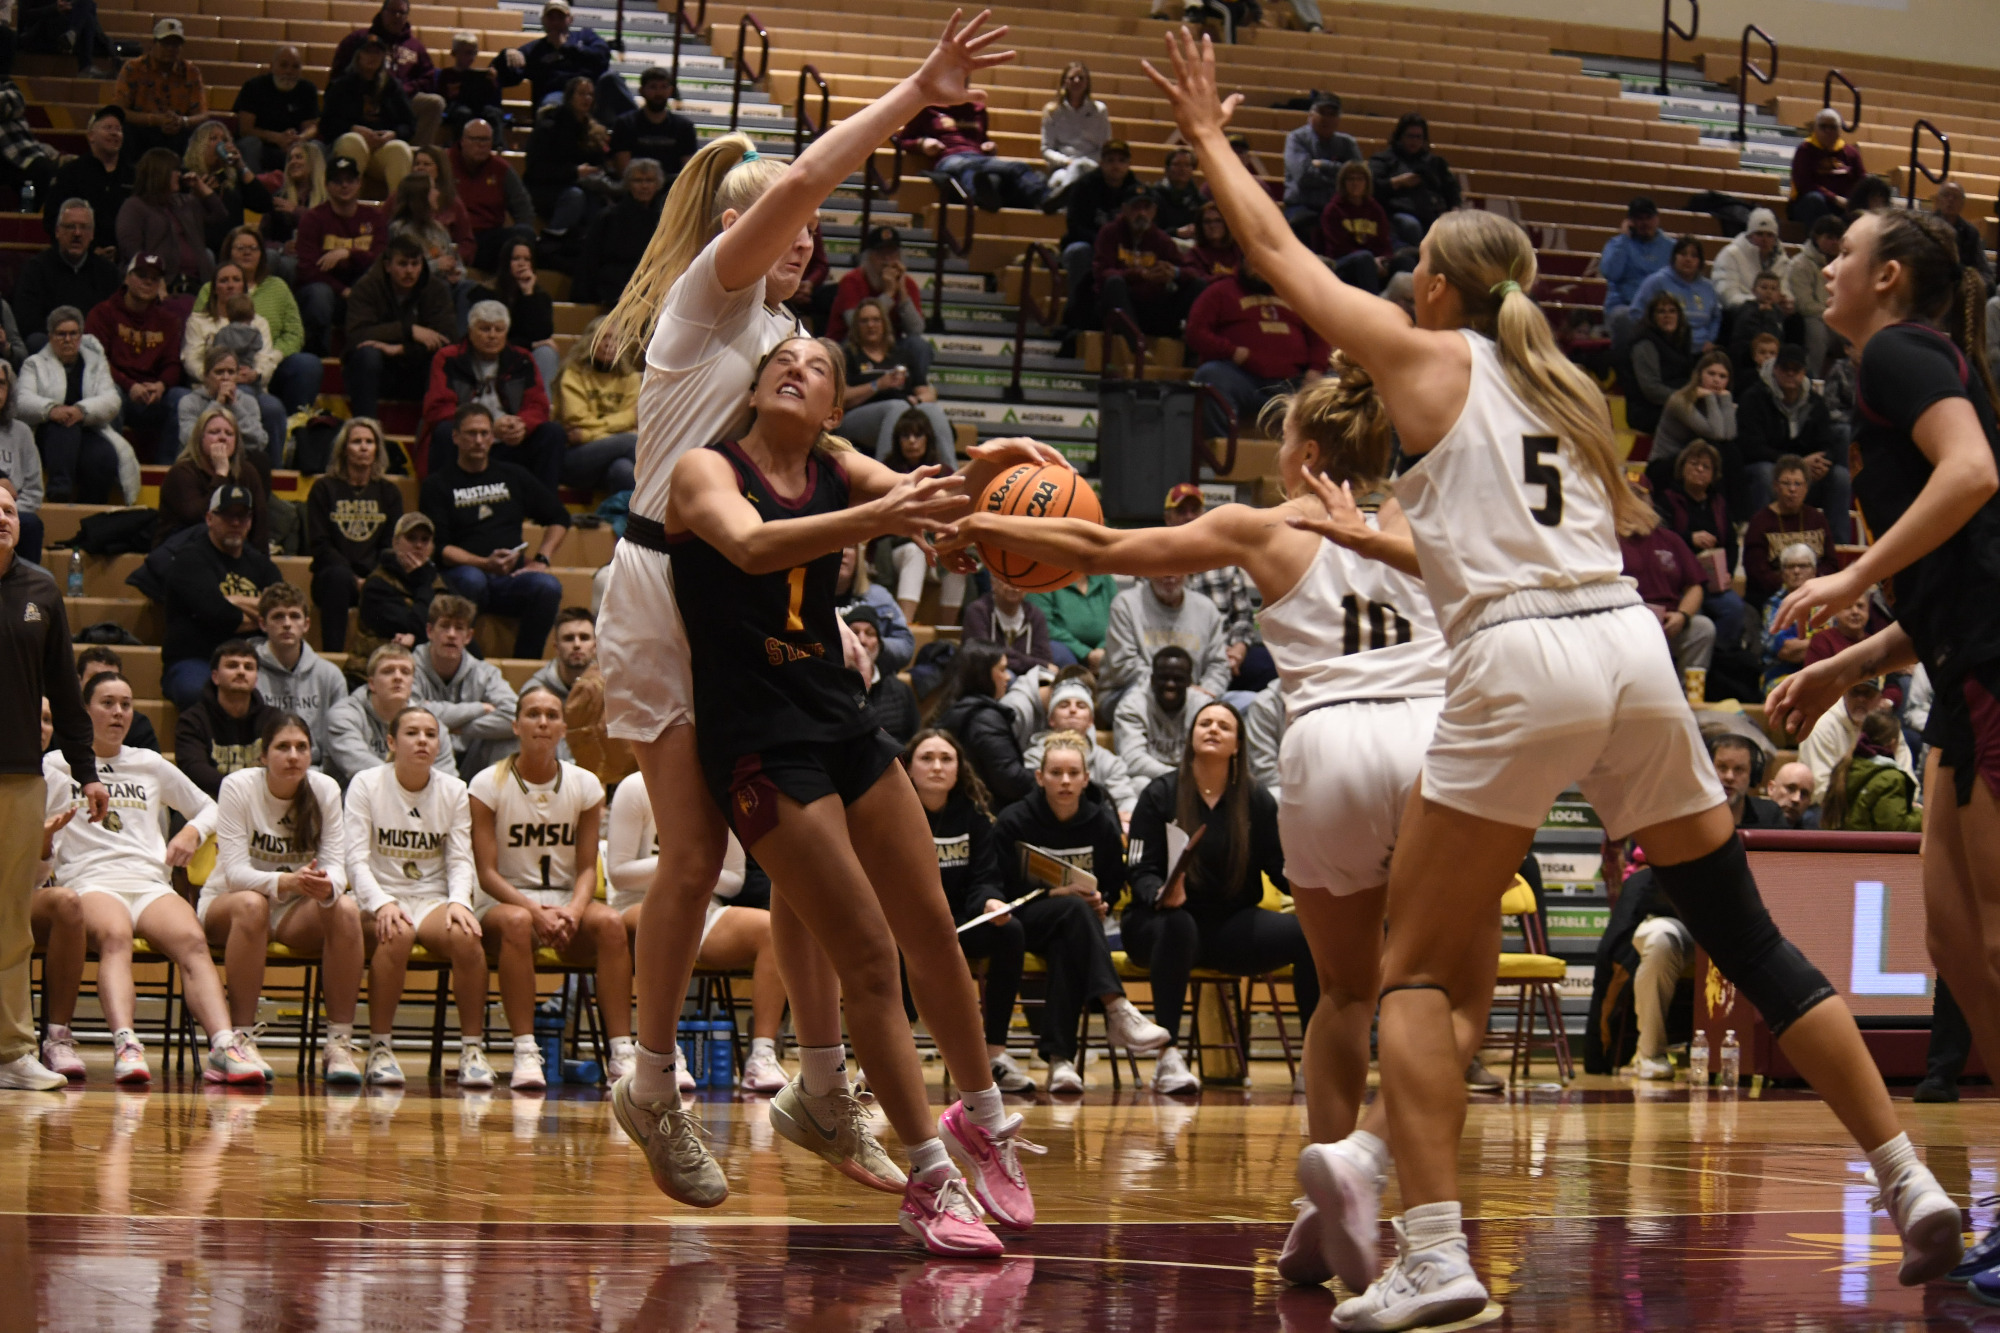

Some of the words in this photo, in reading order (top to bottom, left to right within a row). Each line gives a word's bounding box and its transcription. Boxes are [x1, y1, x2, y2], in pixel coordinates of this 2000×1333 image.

[1026, 481, 1058, 517] CAA
[1522, 434, 1563, 528] 5
[784, 566, 808, 632] 1
[1342, 593, 1411, 656] 10
[71, 782, 147, 802] MTANG
[508, 822, 576, 848] SMSU
[539, 854, 551, 886] 1
[1541, 862, 1576, 873] TEGRA
[1849, 880, 1930, 996] L
